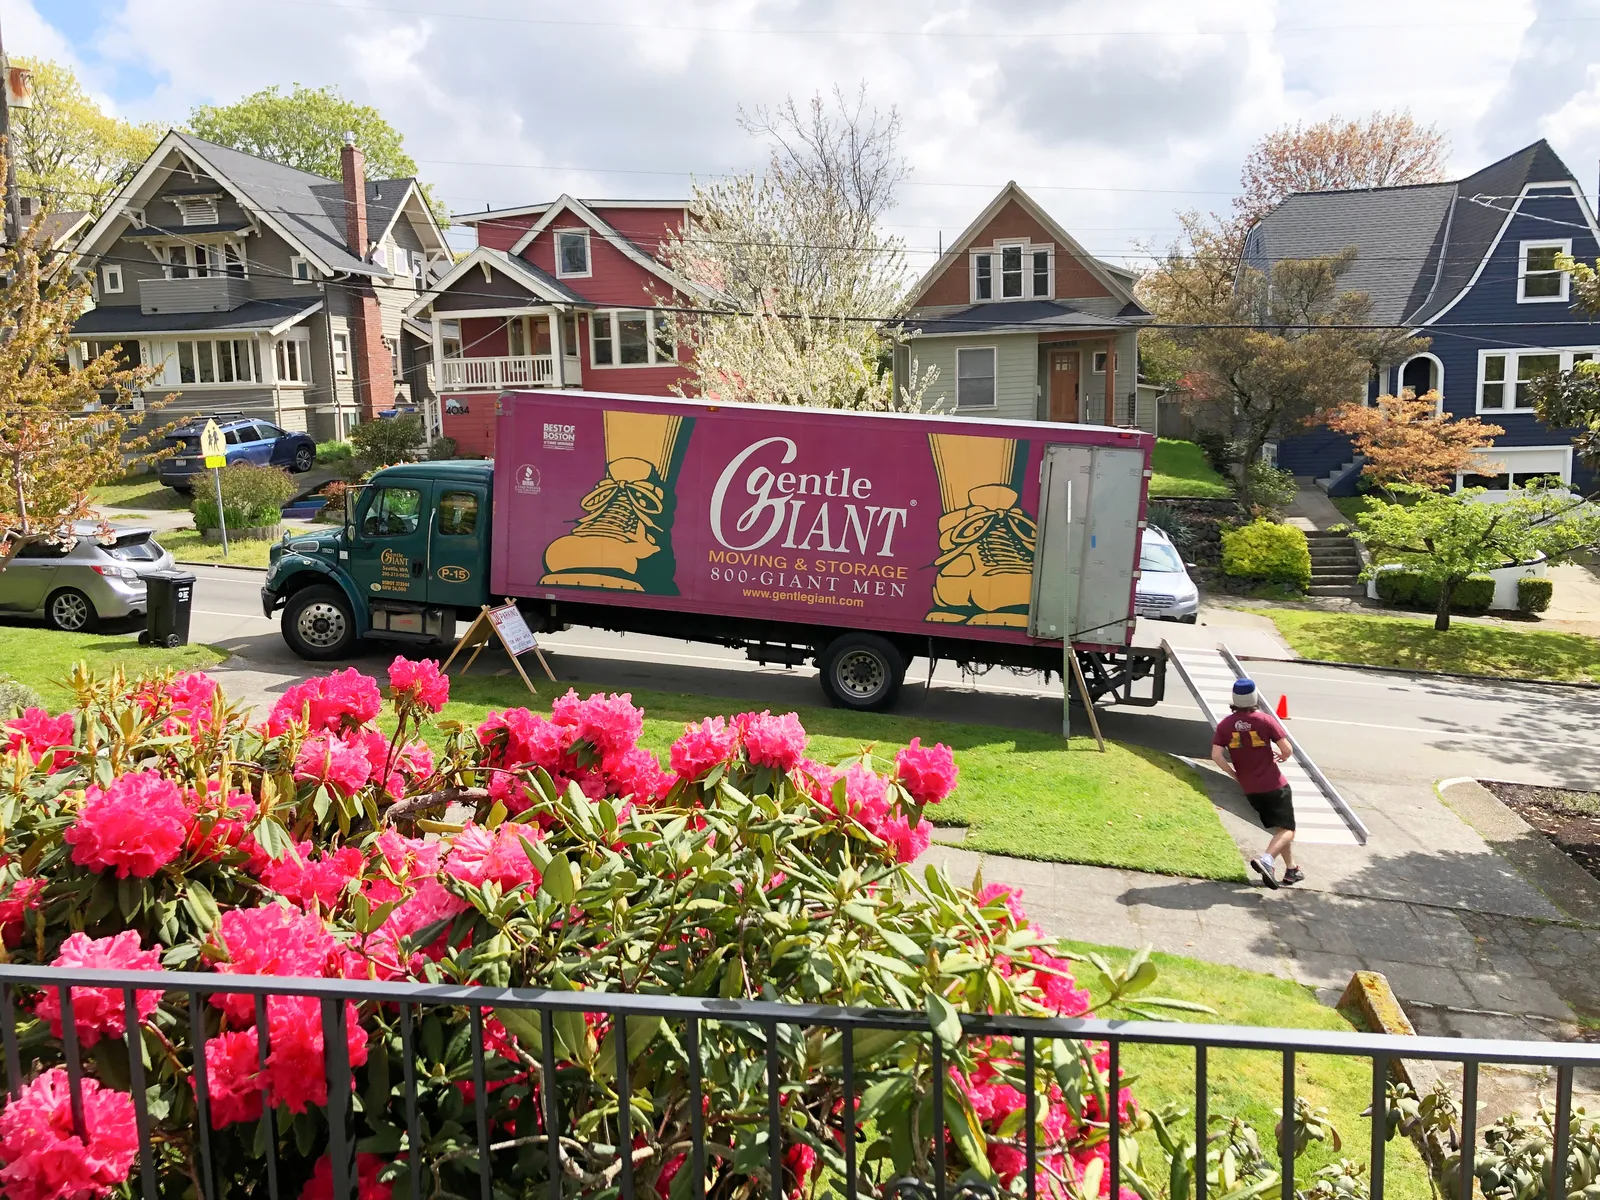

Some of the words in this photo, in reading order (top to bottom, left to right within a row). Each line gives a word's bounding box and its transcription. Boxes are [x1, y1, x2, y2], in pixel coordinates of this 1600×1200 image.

[445, 406, 470, 415] 4034
[543, 423, 563, 433] BEST
[563, 425, 576, 433] OF
[543, 431, 576, 442] BOSTON
[708, 550, 788, 569] MOVING
[794, 558, 808, 571] &
[814, 559, 909, 580] STORAGE
[441, 568, 466, 580] P-15
[710, 567, 840, 592] 800-GIANT
[852, 579, 906, 598] MEN
[742, 588, 864, 608] www.gentlegiant.com
